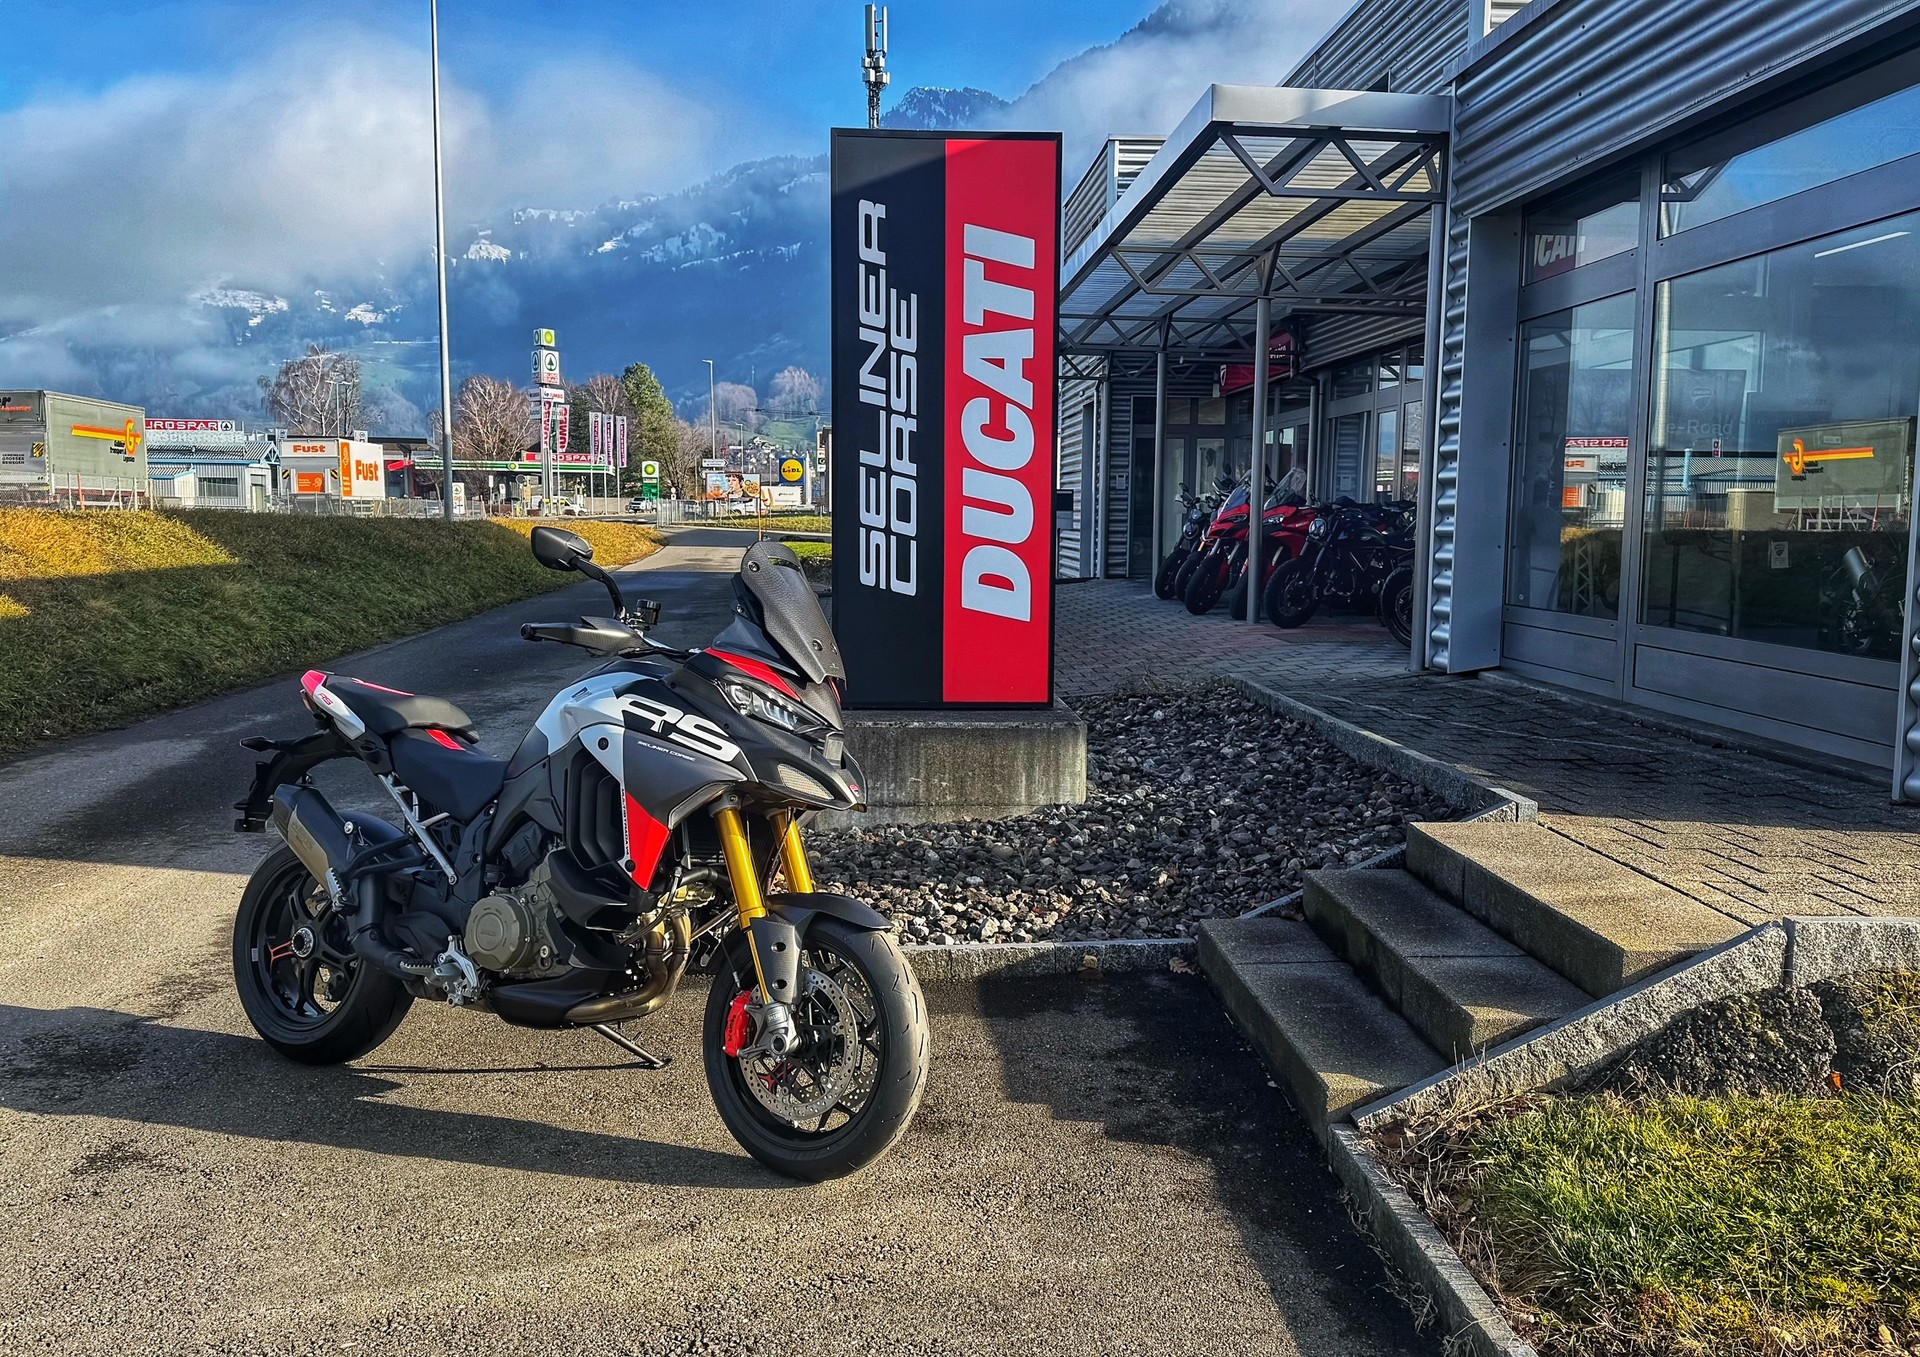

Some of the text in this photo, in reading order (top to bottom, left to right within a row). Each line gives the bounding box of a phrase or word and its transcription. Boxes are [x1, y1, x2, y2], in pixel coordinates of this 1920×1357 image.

[145, 420, 218, 430] UROSPAR
[859, 198, 887, 590] SELINER
[890, 288, 918, 597] CORSE
[961, 223, 1035, 622] DUCATI
[617, 694, 740, 762] RS
[637, 740, 696, 761] SELINER CORSE
